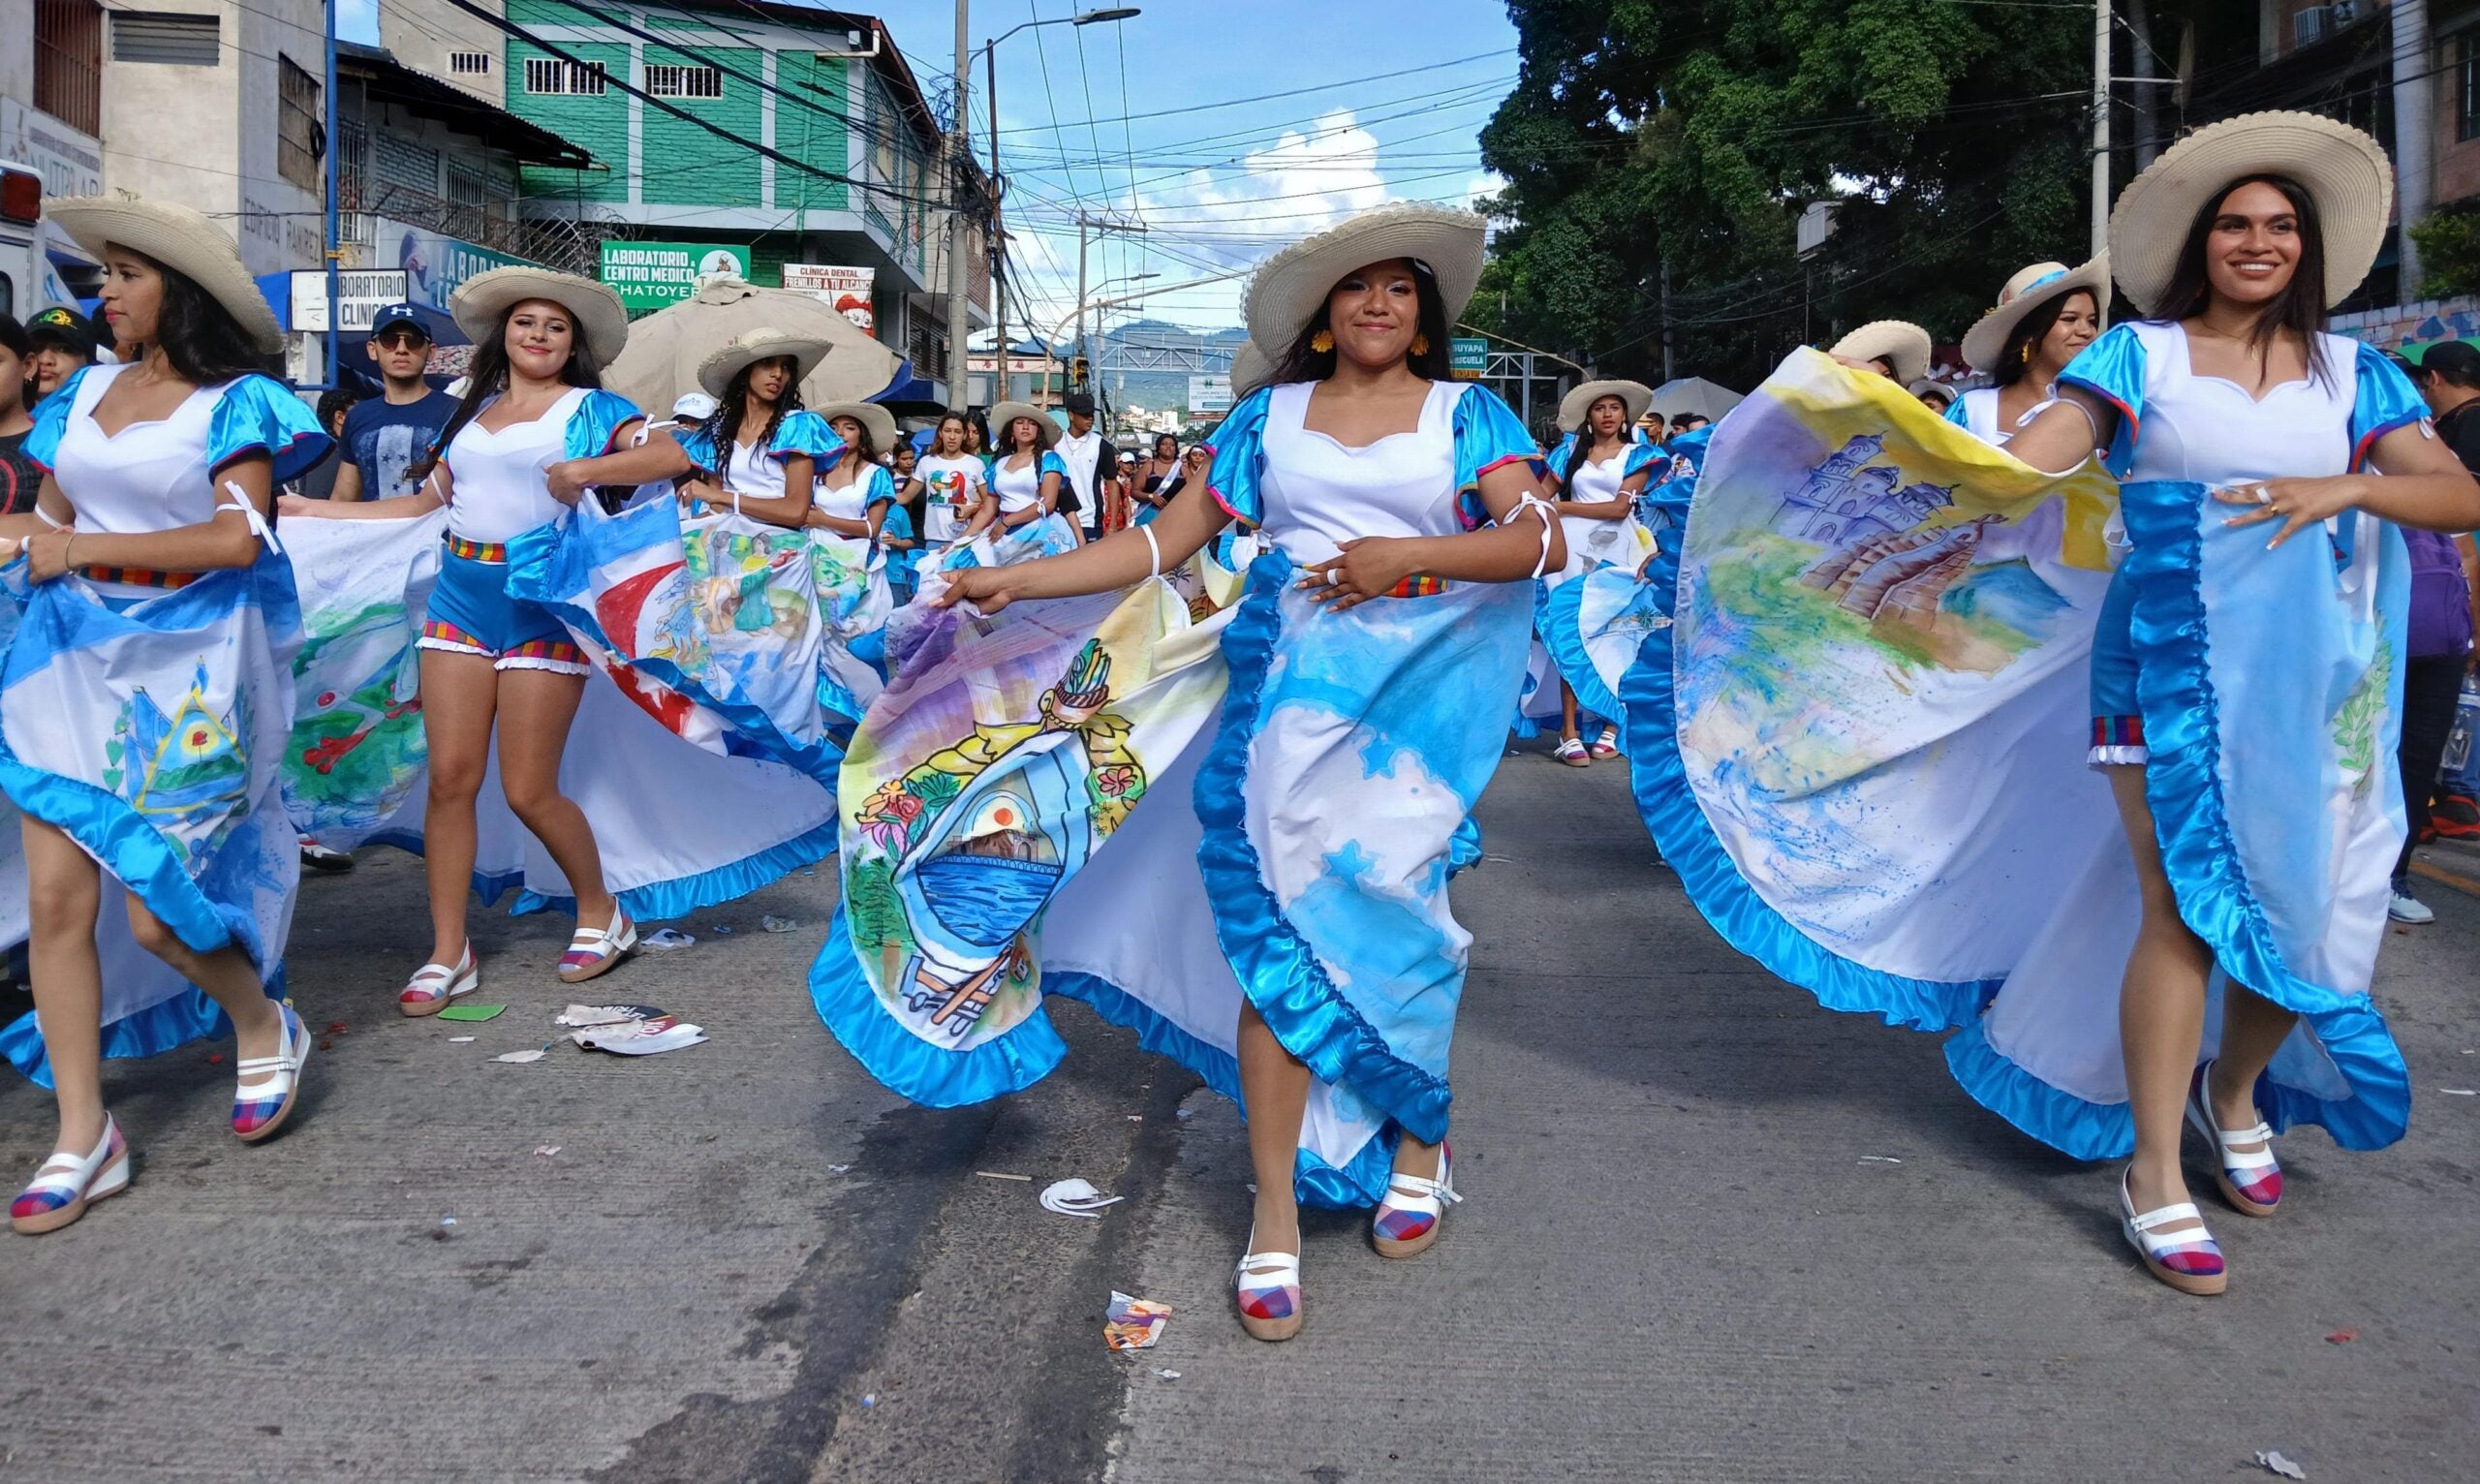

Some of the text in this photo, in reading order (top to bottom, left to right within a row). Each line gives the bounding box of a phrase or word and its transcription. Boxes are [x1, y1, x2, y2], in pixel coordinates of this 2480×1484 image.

[604, 249, 689, 267] LABORATORIO
[604, 265, 649, 281] CENTRO
[651, 267, 695, 283] MEDICO
[800, 267, 859, 278] CLÍNICA DENTAL
[326, 276, 405, 298] BORATORIO
[785, 277, 822, 290] FRENILLOS
[823, 279, 829, 290] A
[830, 279, 841, 290] TU
[342, 303, 388, 325] CLINIC
